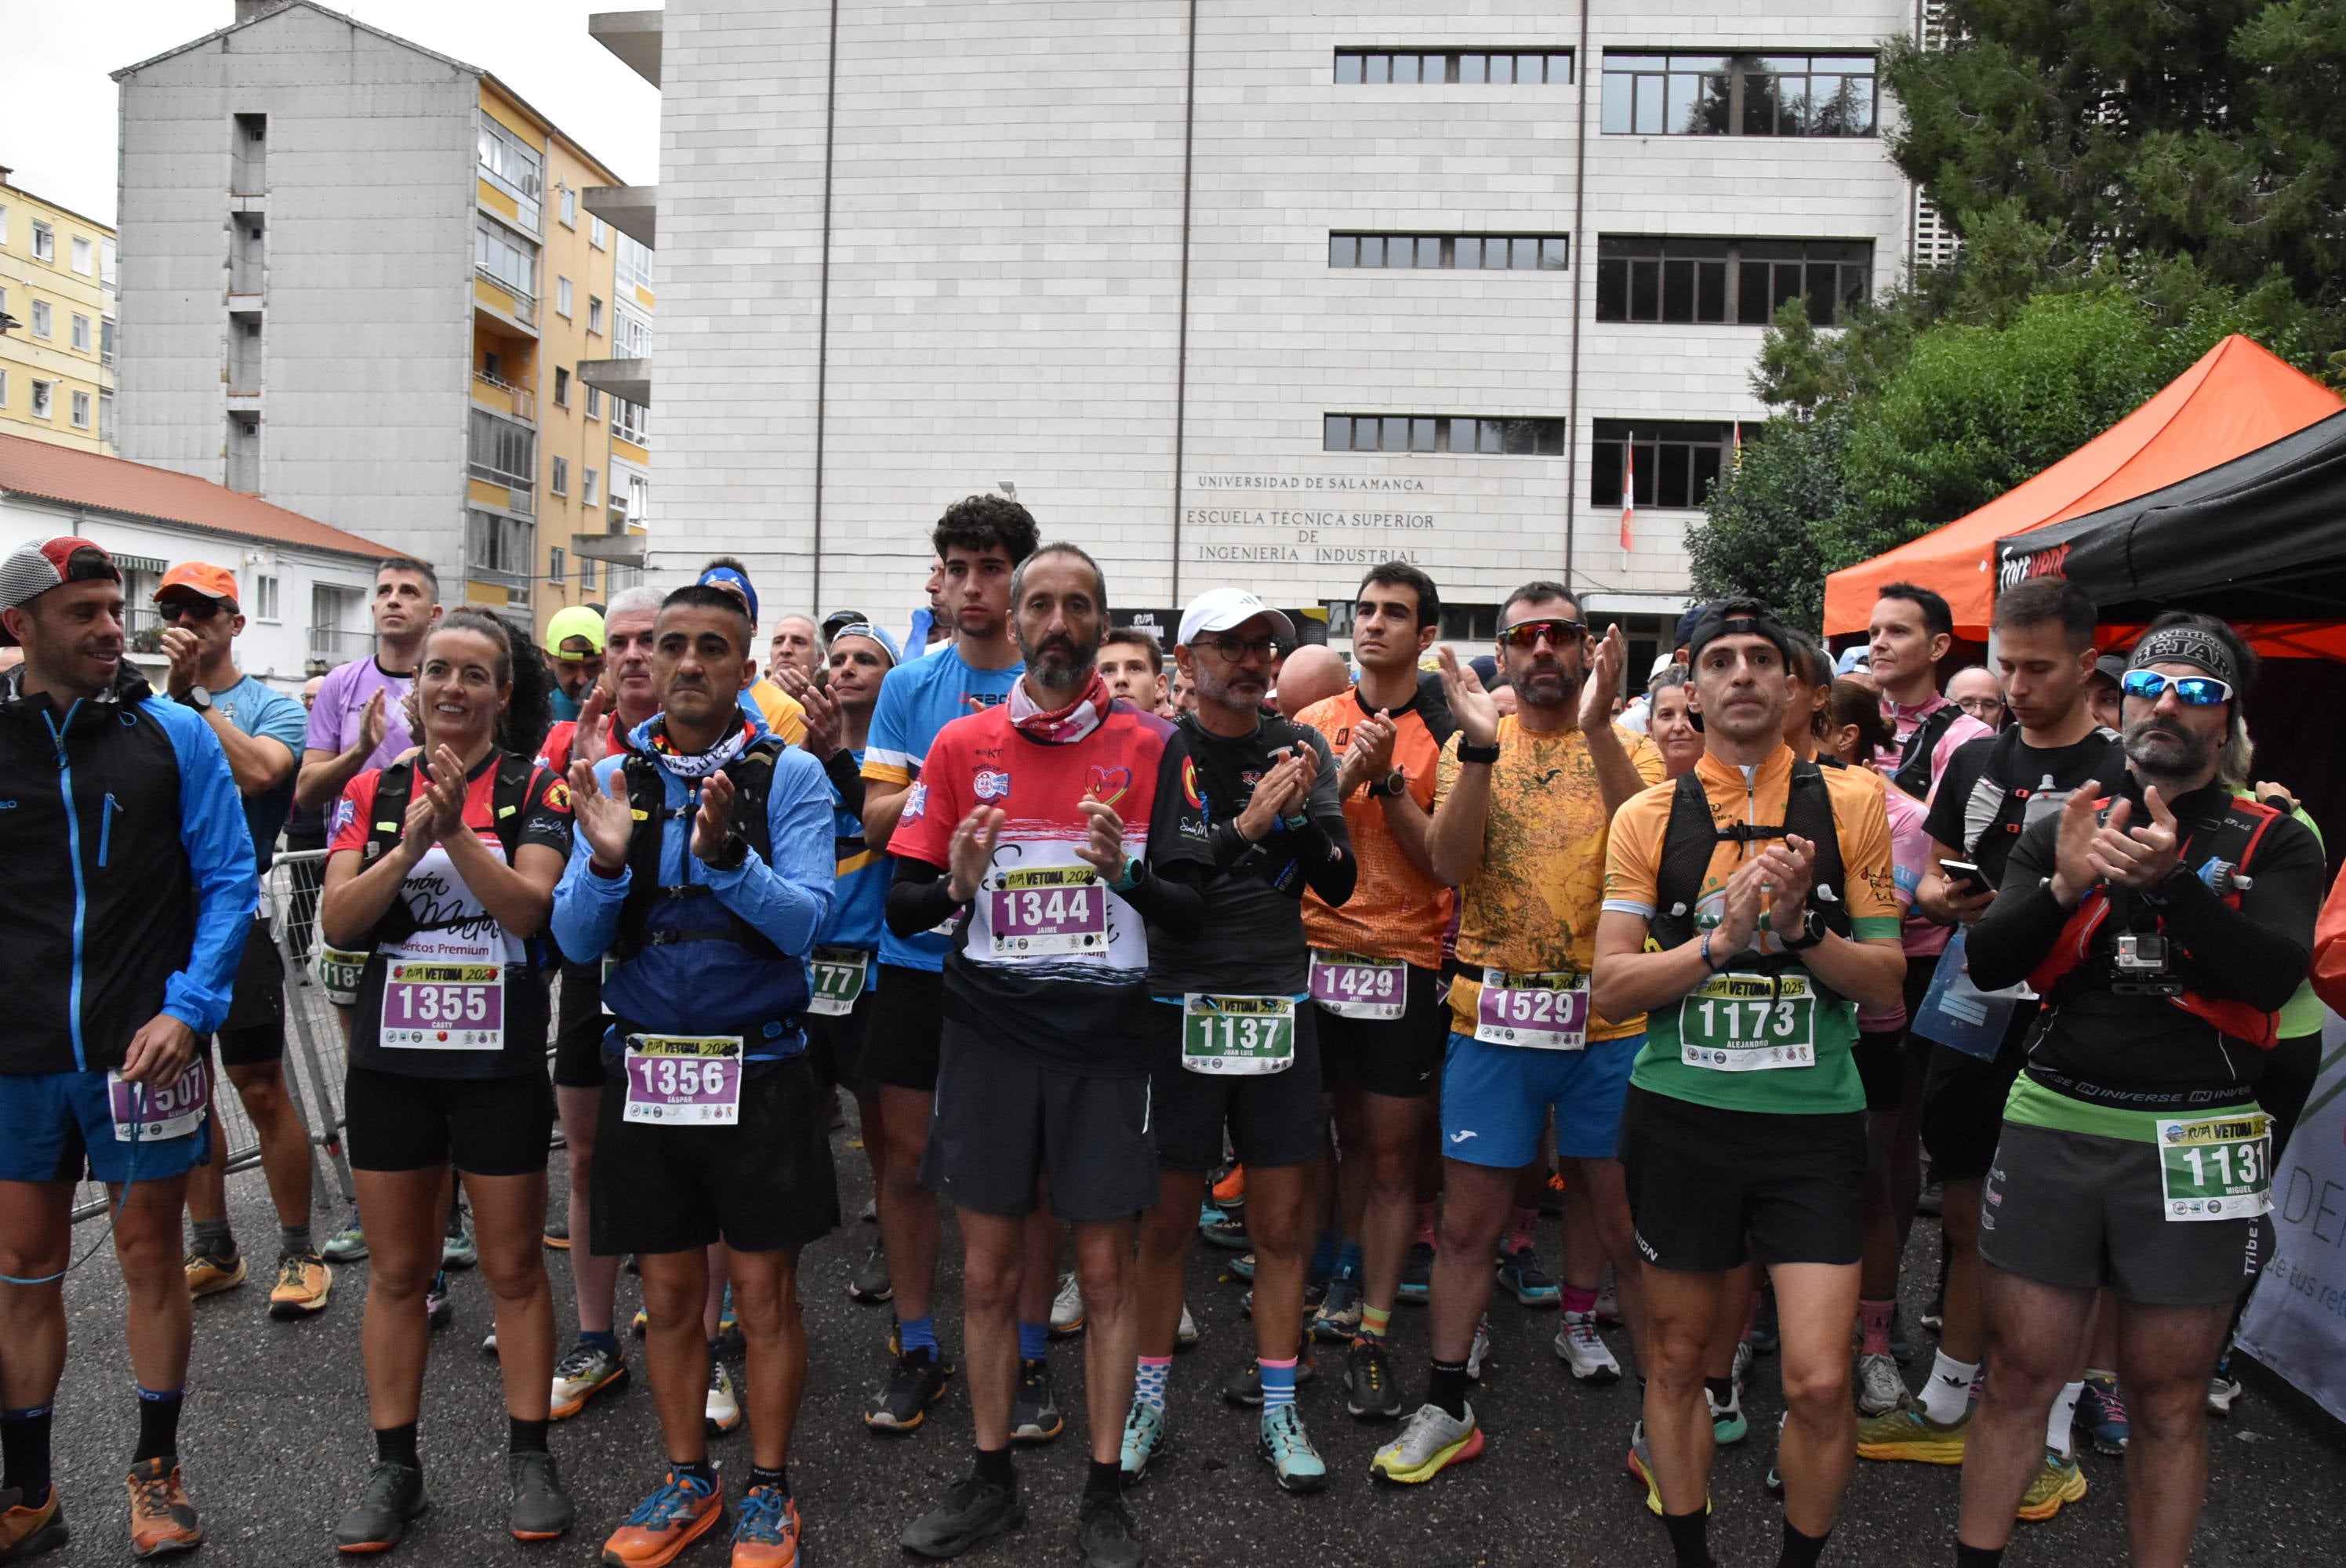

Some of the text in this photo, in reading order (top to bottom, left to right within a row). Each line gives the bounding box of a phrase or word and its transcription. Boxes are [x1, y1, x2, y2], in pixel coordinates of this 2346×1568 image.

[1198, 476, 1425, 491] UNIVERSIDAD DE SALAMANCA
[1186, 510, 1266, 524] ESCUELA
[1352, 514, 1434, 528] SUPERIOR
[1298, 530, 1319, 543] DE
[1316, 548, 1420, 564] INDUSTRIAL
[1004, 889, 1090, 926] 1344
[438, 944, 489, 956] Premium
[425, 967, 462, 980] VETONA
[1324, 967, 1393, 996] 1429
[1728, 981, 1771, 996] VETONA
[399, 985, 487, 1021] 1355
[1225, 1000, 1258, 1013] VETONA
[1494, 989, 1574, 1024] 1529
[1698, 1000, 1795, 1039] 1173
[1199, 1017, 1280, 1049] 1137
[1727, 1040, 1769, 1049] ALEJANDRO
[639, 1059, 725, 1095] 1356
[666, 1095, 694, 1104] GASPAR
[2097, 1088, 2184, 1102] INVERSE
[2188, 1124, 2211, 1140] RUTA
[2213, 1122, 2252, 1139] VETONA
[2183, 1141, 2265, 1186] 1131
[2225, 1185, 2253, 1195] MIGUEL
[2289, 1265, 2317, 1298] tus
